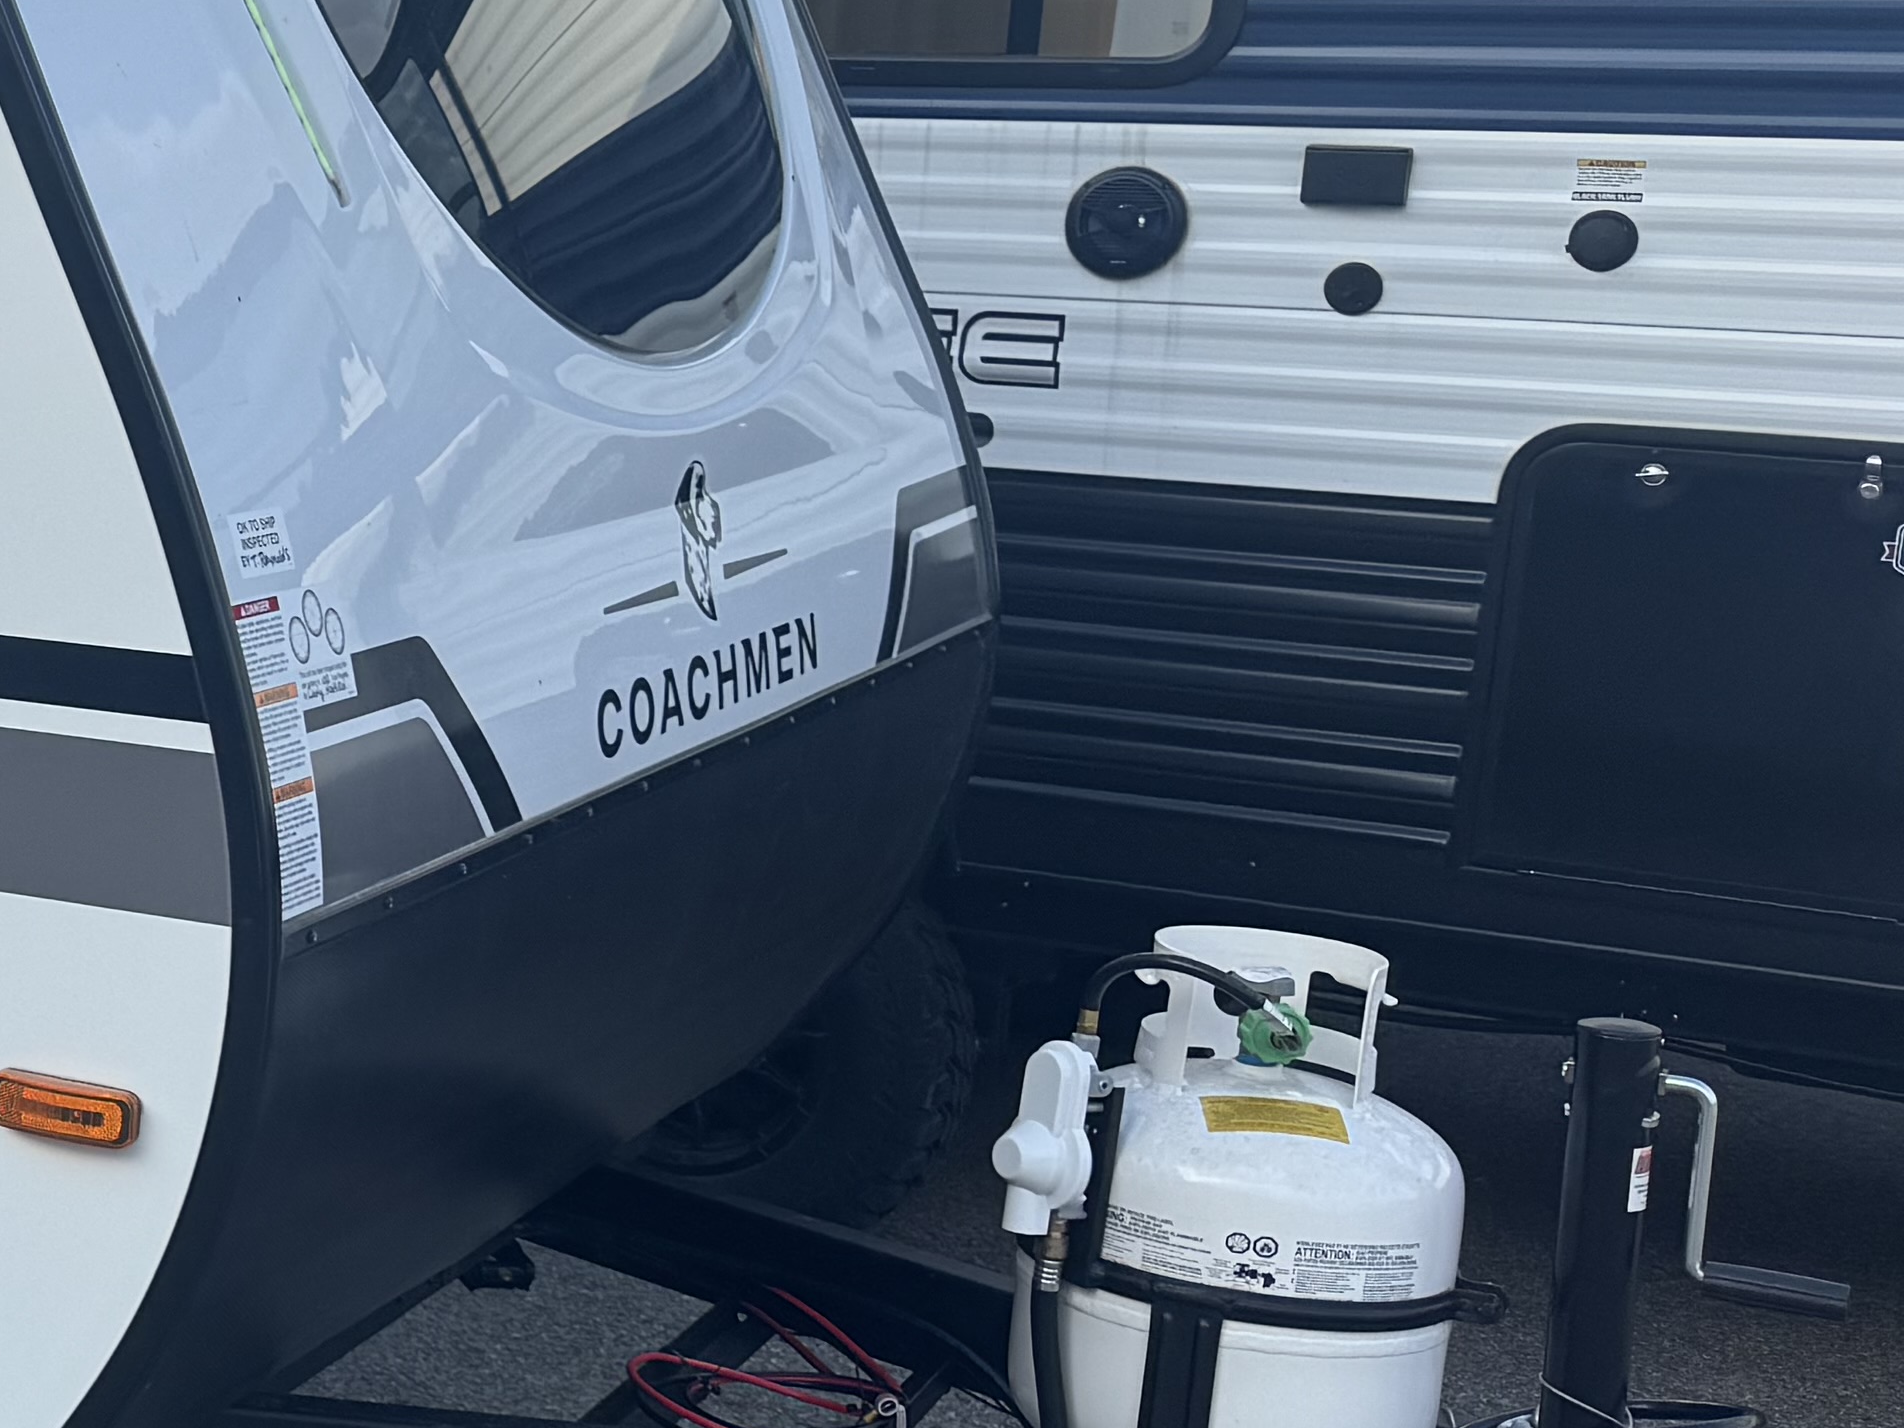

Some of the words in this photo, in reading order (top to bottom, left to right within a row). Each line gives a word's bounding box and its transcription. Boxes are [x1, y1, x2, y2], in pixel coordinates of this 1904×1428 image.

[237, 521, 249, 534] OK
[248, 518, 260, 532] TO
[240, 532, 280, 551] INSPECTED
[597, 612, 818, 758] COACHMEN
